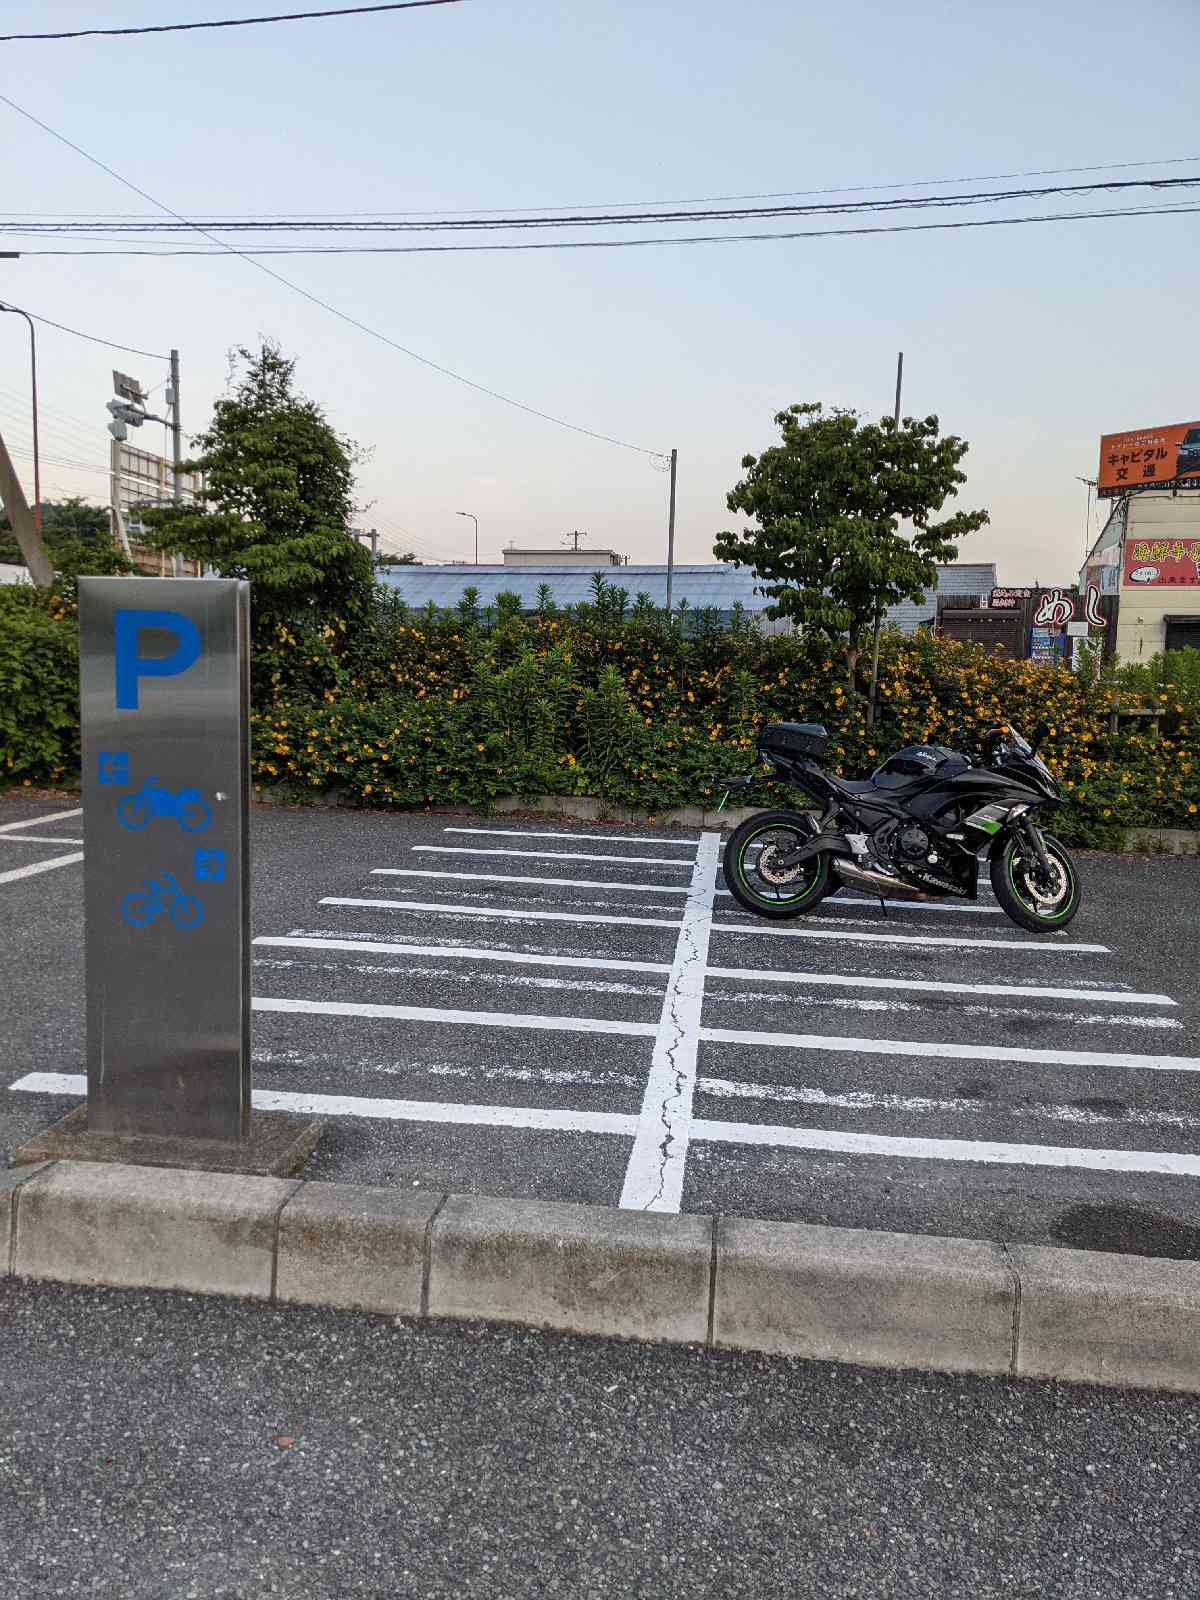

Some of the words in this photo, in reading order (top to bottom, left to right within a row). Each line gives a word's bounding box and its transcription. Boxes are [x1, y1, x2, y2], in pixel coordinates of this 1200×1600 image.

[1035, 584, 1106, 627] めし
[115, 610, 201, 709] P
[922, 872, 968, 895] Kawasaki
